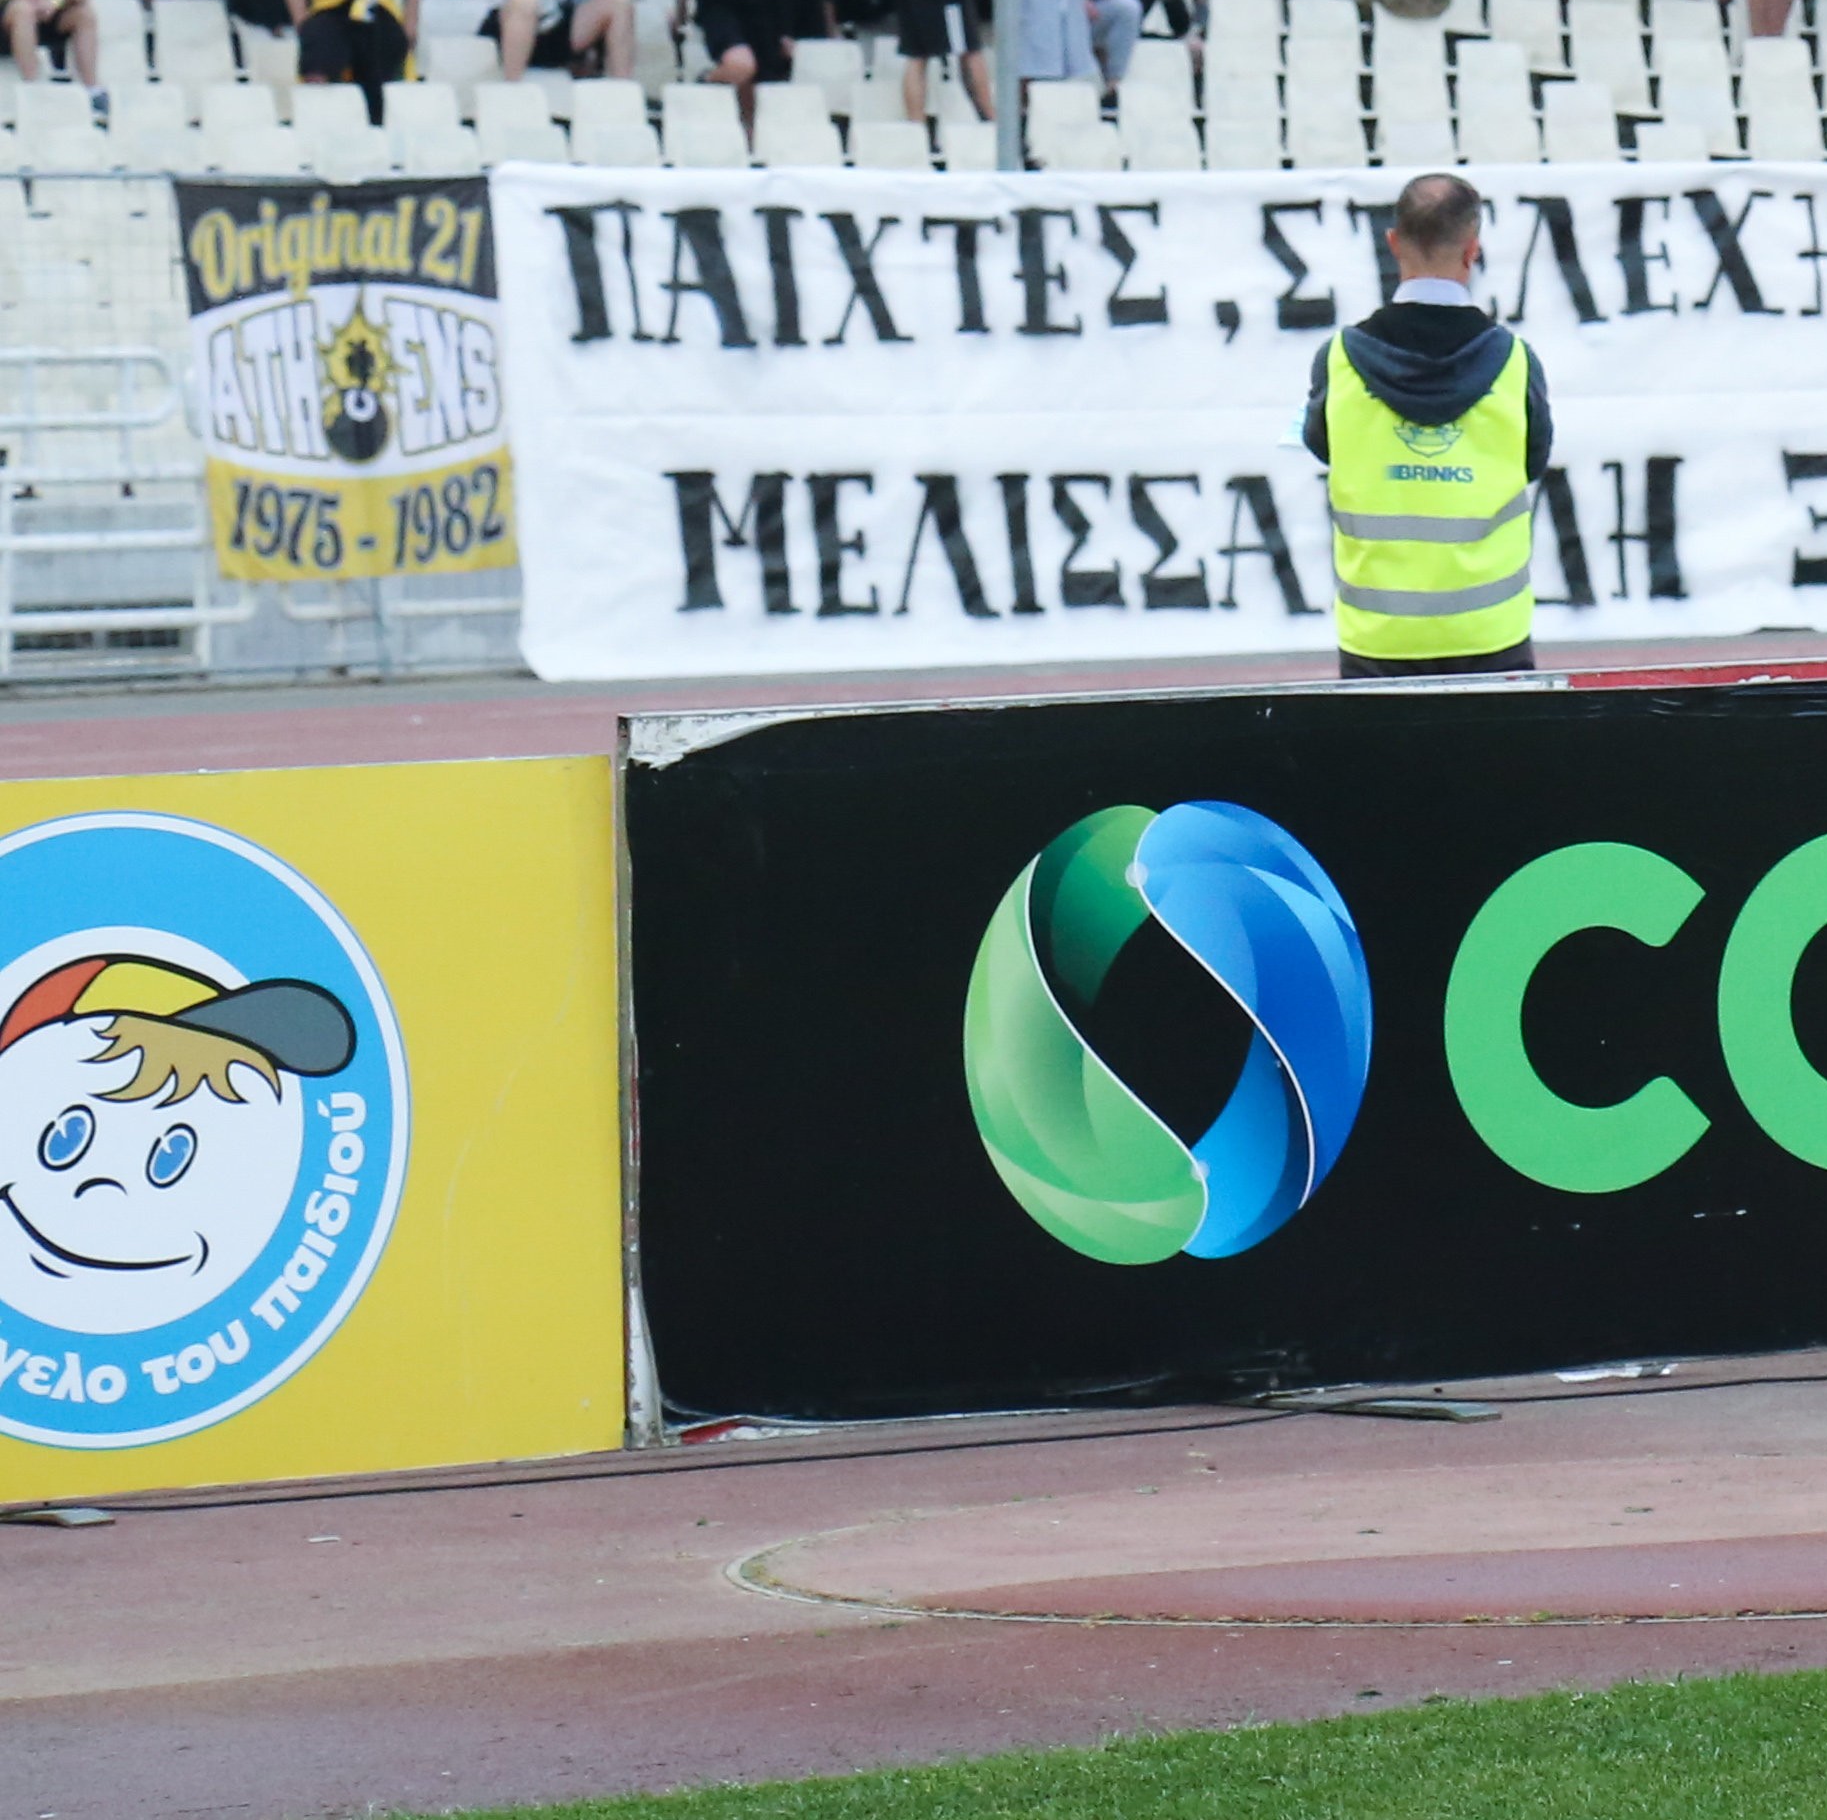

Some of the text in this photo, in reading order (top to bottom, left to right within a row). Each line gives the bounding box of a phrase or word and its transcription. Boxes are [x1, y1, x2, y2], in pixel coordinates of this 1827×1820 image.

[190, 192, 483, 300] Original 21
[231, 482, 344, 570] 1975
[389, 464, 505, 568] 1982
[141, 1319, 251, 1395] του
[251, 1090, 368, 1331] παιδιού
